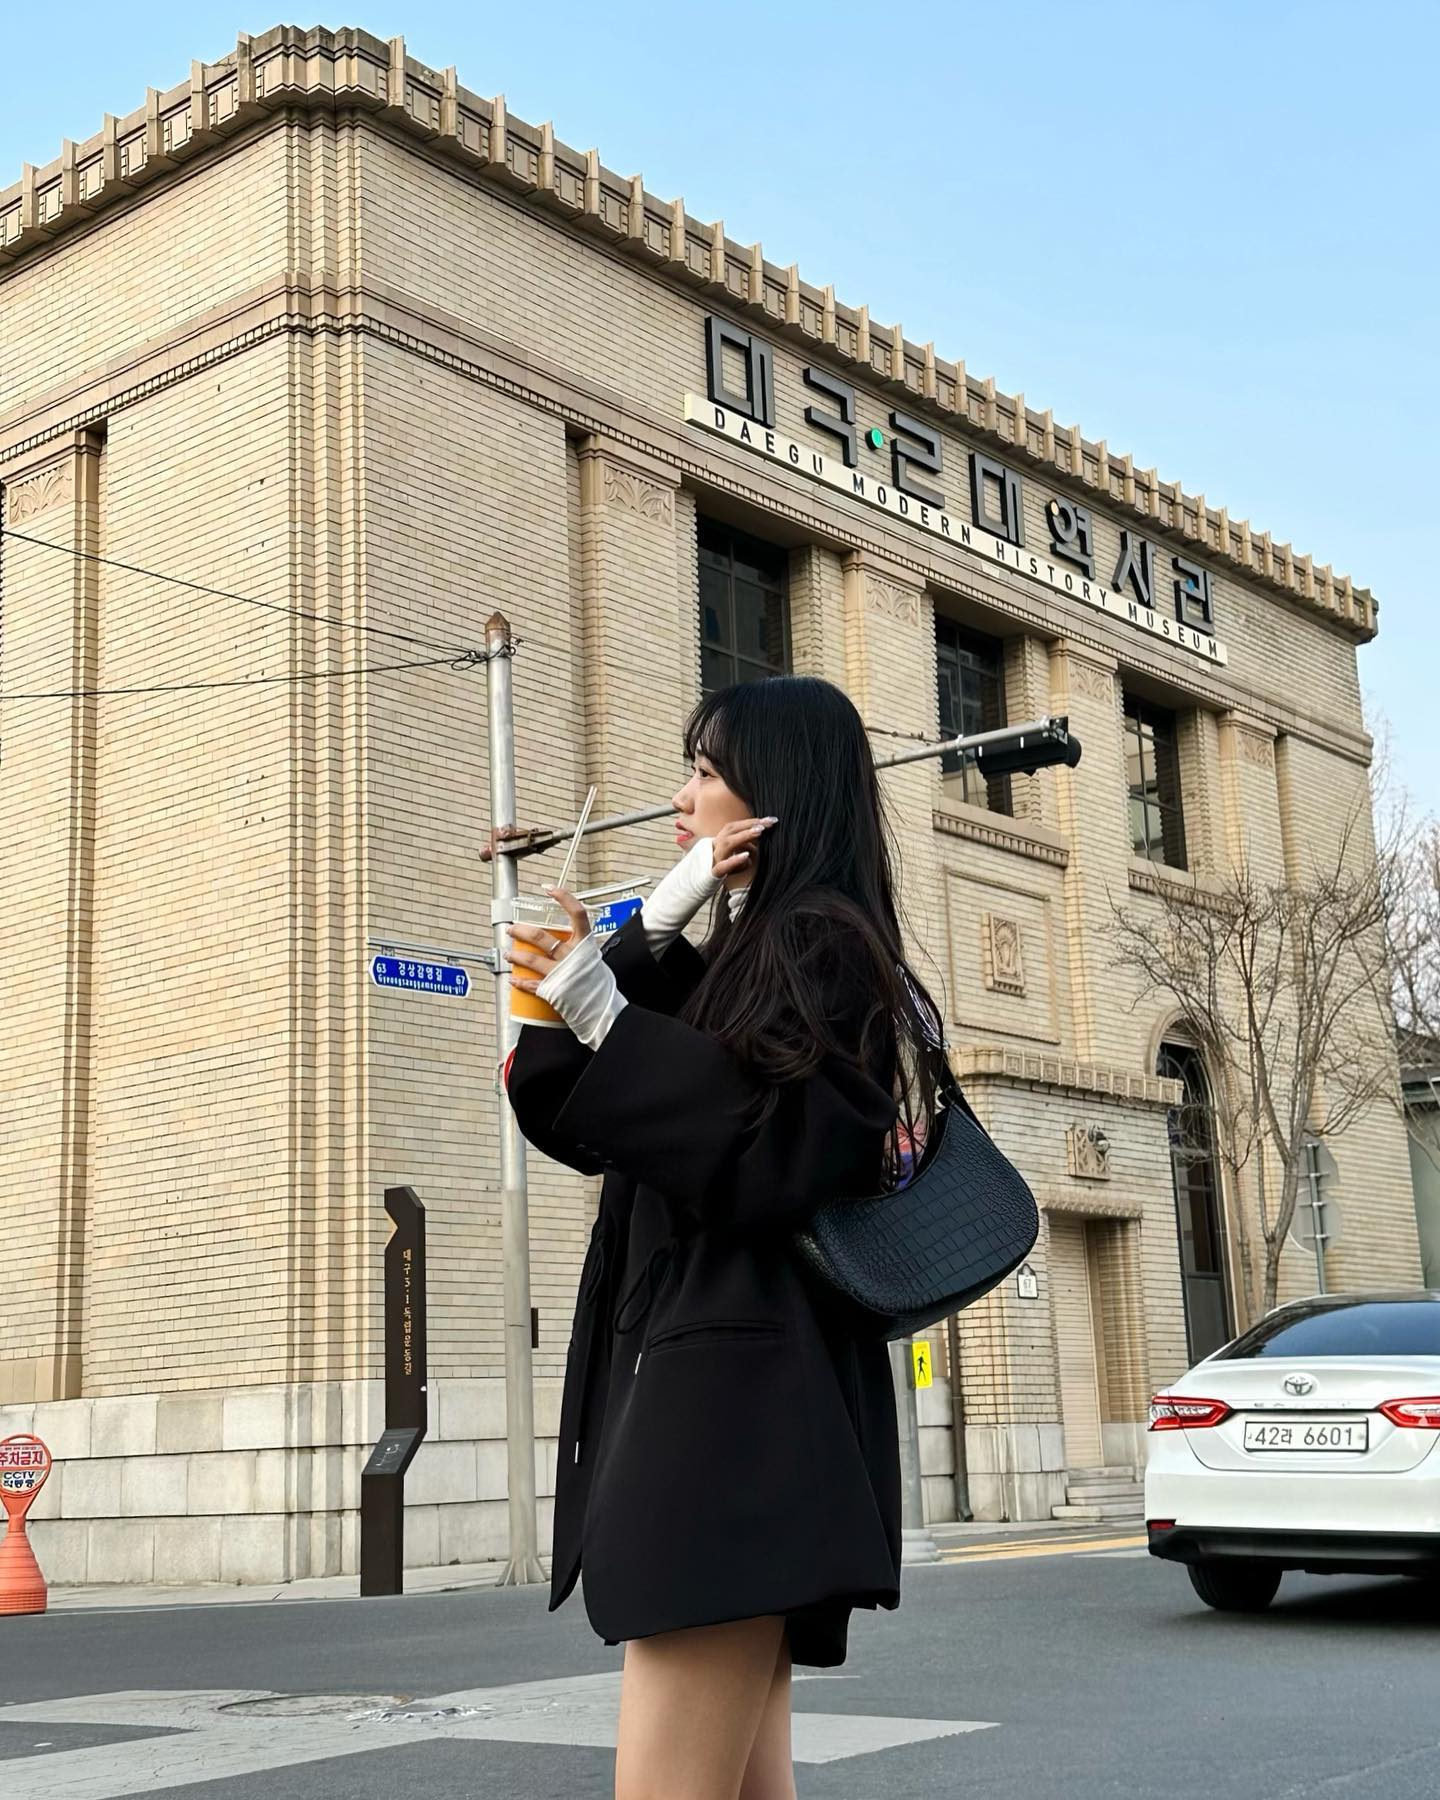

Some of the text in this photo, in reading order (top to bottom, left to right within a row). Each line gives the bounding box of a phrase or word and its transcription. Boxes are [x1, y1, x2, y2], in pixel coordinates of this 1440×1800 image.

[714, 407, 1218, 658] DAEGU MODERN HISTORY MUSEUM
[376, 963, 387, 974] 63
[398, 962, 443, 981] 경상감영길
[455, 975, 466, 986] 67
[1254, 1427, 1353, 1446] 42라 6601
[3, 1471, 35, 1479] CCTV
